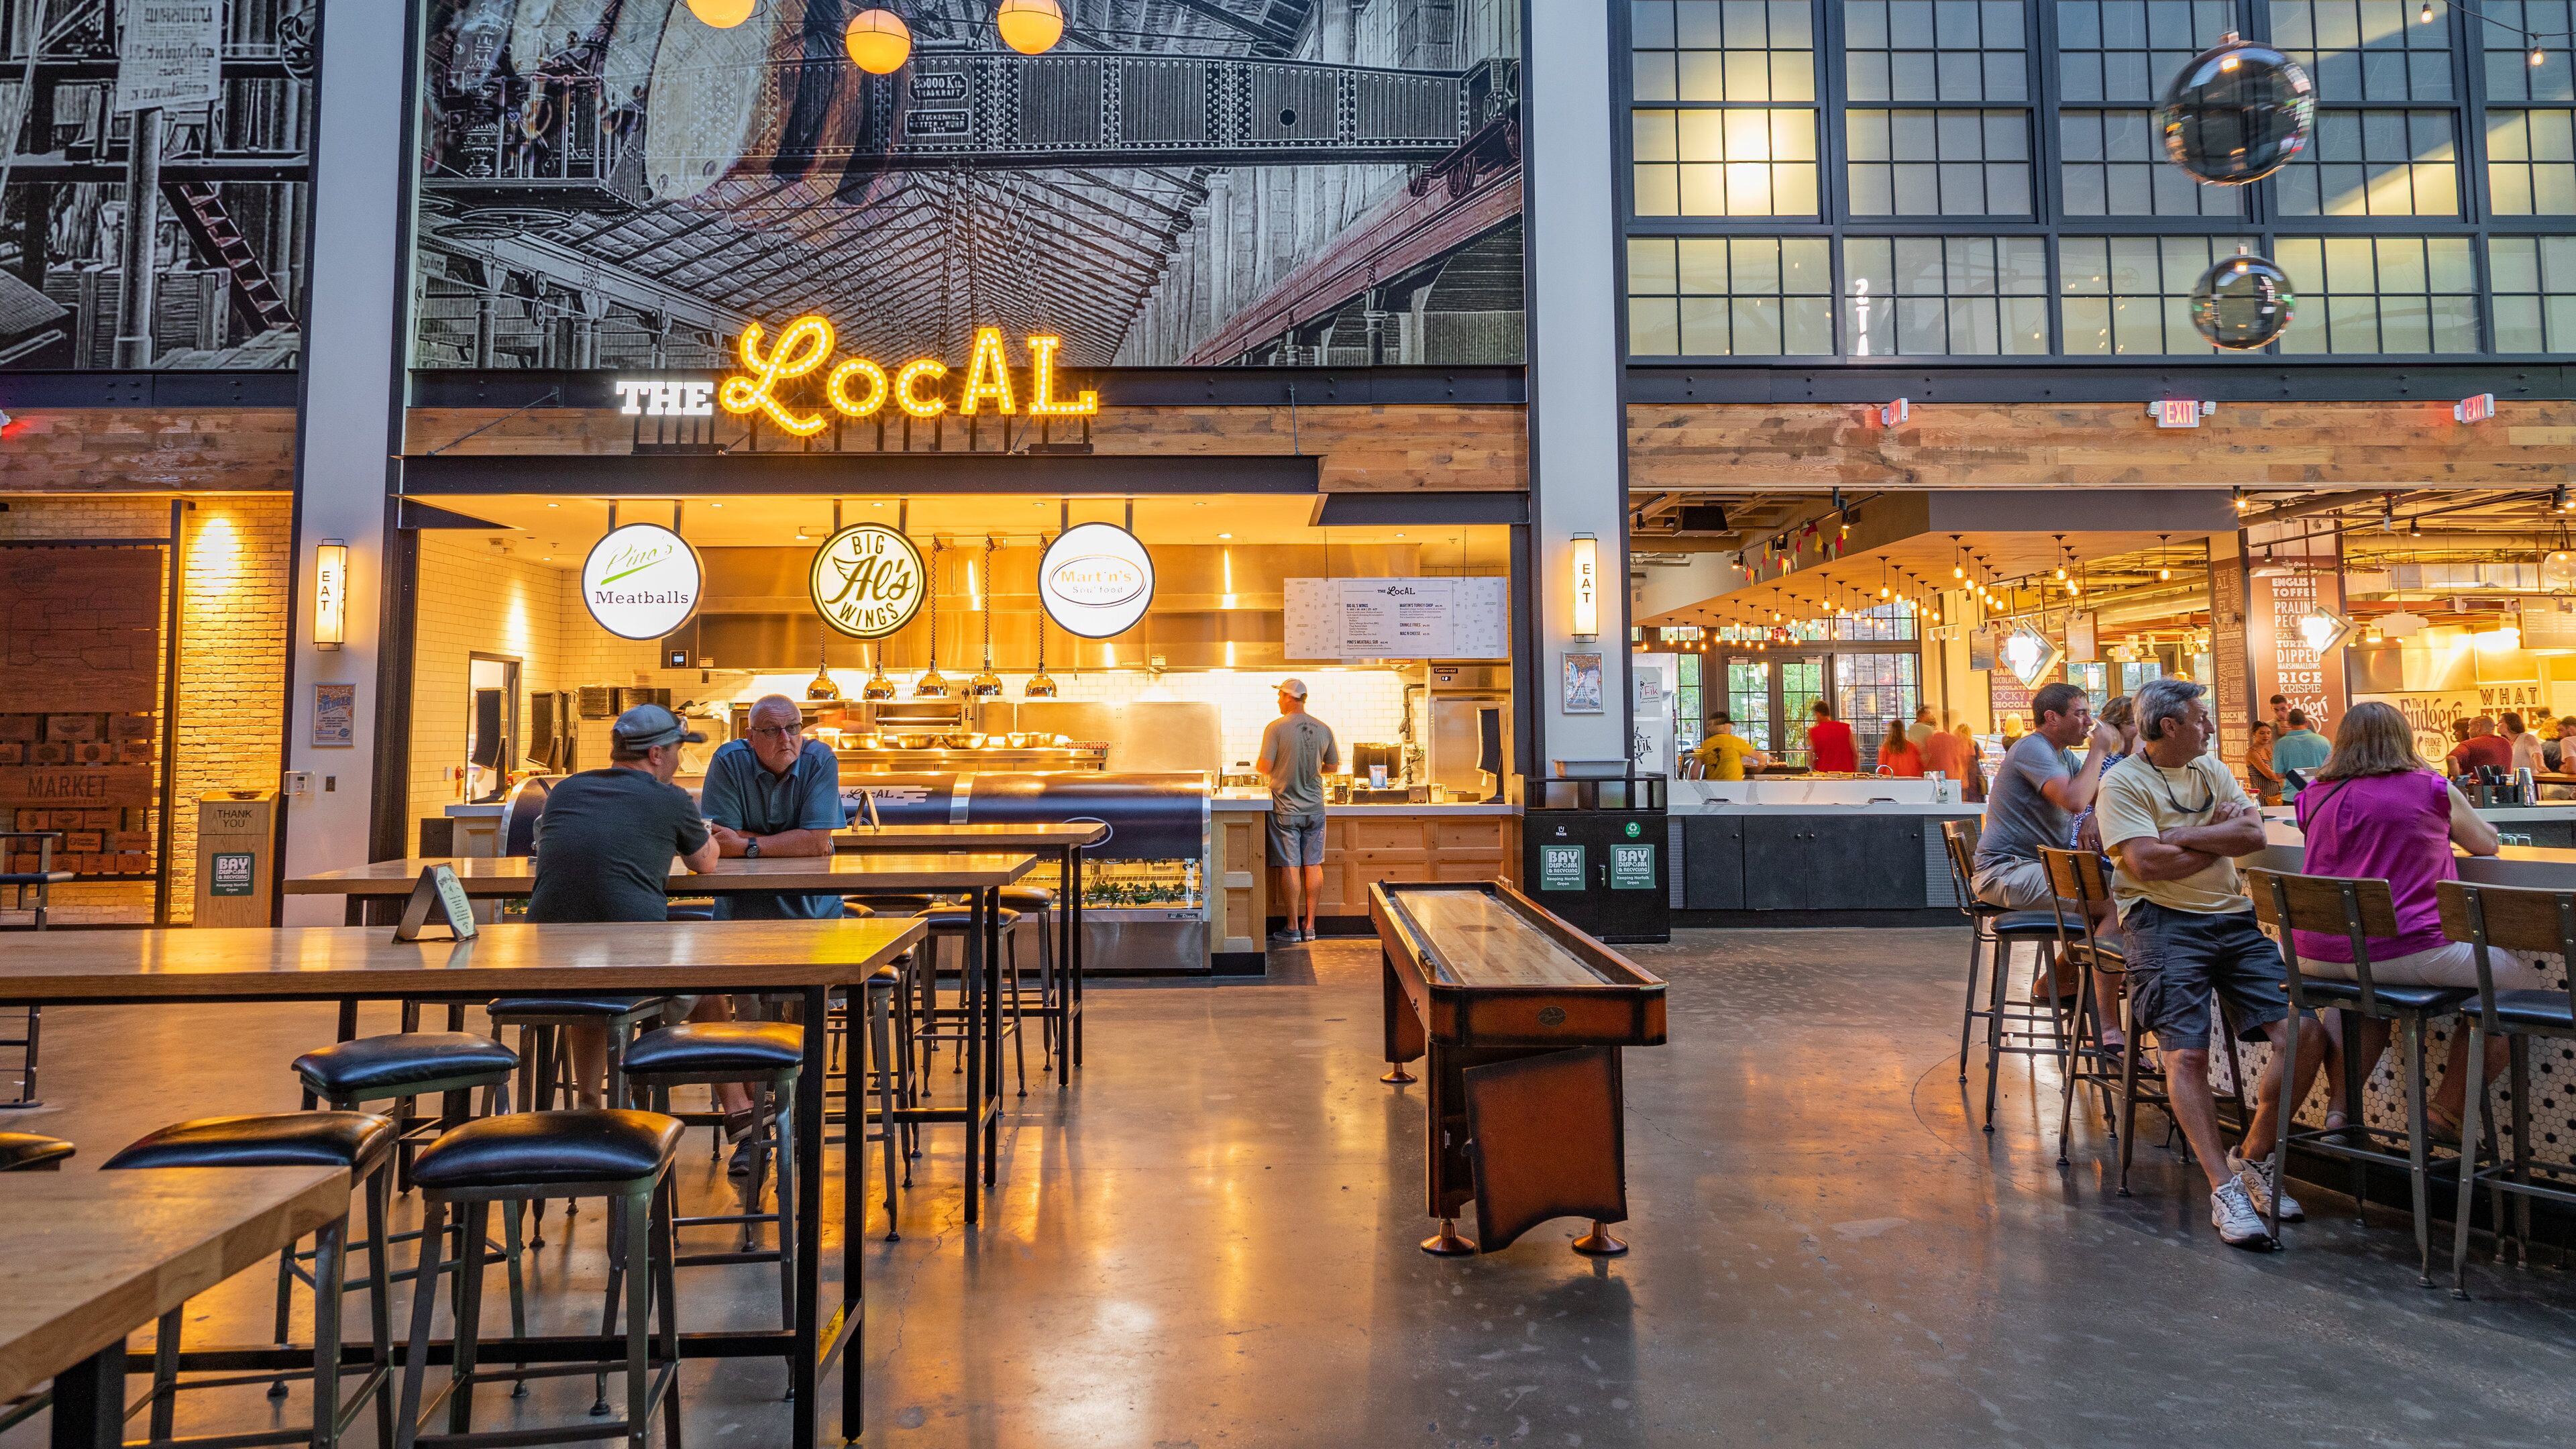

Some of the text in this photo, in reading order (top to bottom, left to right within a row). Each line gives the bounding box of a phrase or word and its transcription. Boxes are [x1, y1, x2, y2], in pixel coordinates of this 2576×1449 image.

[616, 381, 714, 415] THE
[2166, 402, 2194, 423] EXIT
[2465, 394, 2485, 421] EXIT
[851, 533, 885, 555] BIG
[824, 555, 915, 604] Al's
[1061, 570, 1132, 583] Martn's
[2272, 578, 2316, 587] ENGLISH
[1582, 564, 1591, 603] EAT
[2216, 577, 2229, 590] AL
[321, 571, 330, 611] EAT
[2272, 588, 2317, 597] TOFFEE
[595, 591, 688, 604] Meatballs
[2218, 600, 2229, 612] FL
[839, 602, 898, 627] WINGS
[2217, 621, 2241, 633] NOLA
[2275, 614, 2304, 628] PECA
[2217, 639, 2243, 648] BRANSON
[2275, 640, 2308, 648] TURTL
[2277, 649, 2320, 663] DIPPED
[2227, 661, 2243, 670] OXON
[1991, 676, 2017, 684] HOCOLATE
[2277, 672, 2322, 684] RICE
[2279, 684, 2322, 694] KRISPIE
[2220, 696, 2229, 704] SC
[2479, 687, 2537, 705] WHAT
[2412, 698, 2422, 708] The
[2238, 711, 2247, 723] NC
[2222, 729, 2236, 740] PIGEON
[2424, 737, 2441, 747] FUDGE
[2431, 747, 2440, 756] FUN
[28, 775, 109, 797] MARKET
[217, 810, 252, 818] THANK
[223, 819, 246, 827] YOU
[1548, 851, 1577, 863] BAY
[1617, 850, 1647, 862] BAY
[219, 858, 248, 869] BAY
